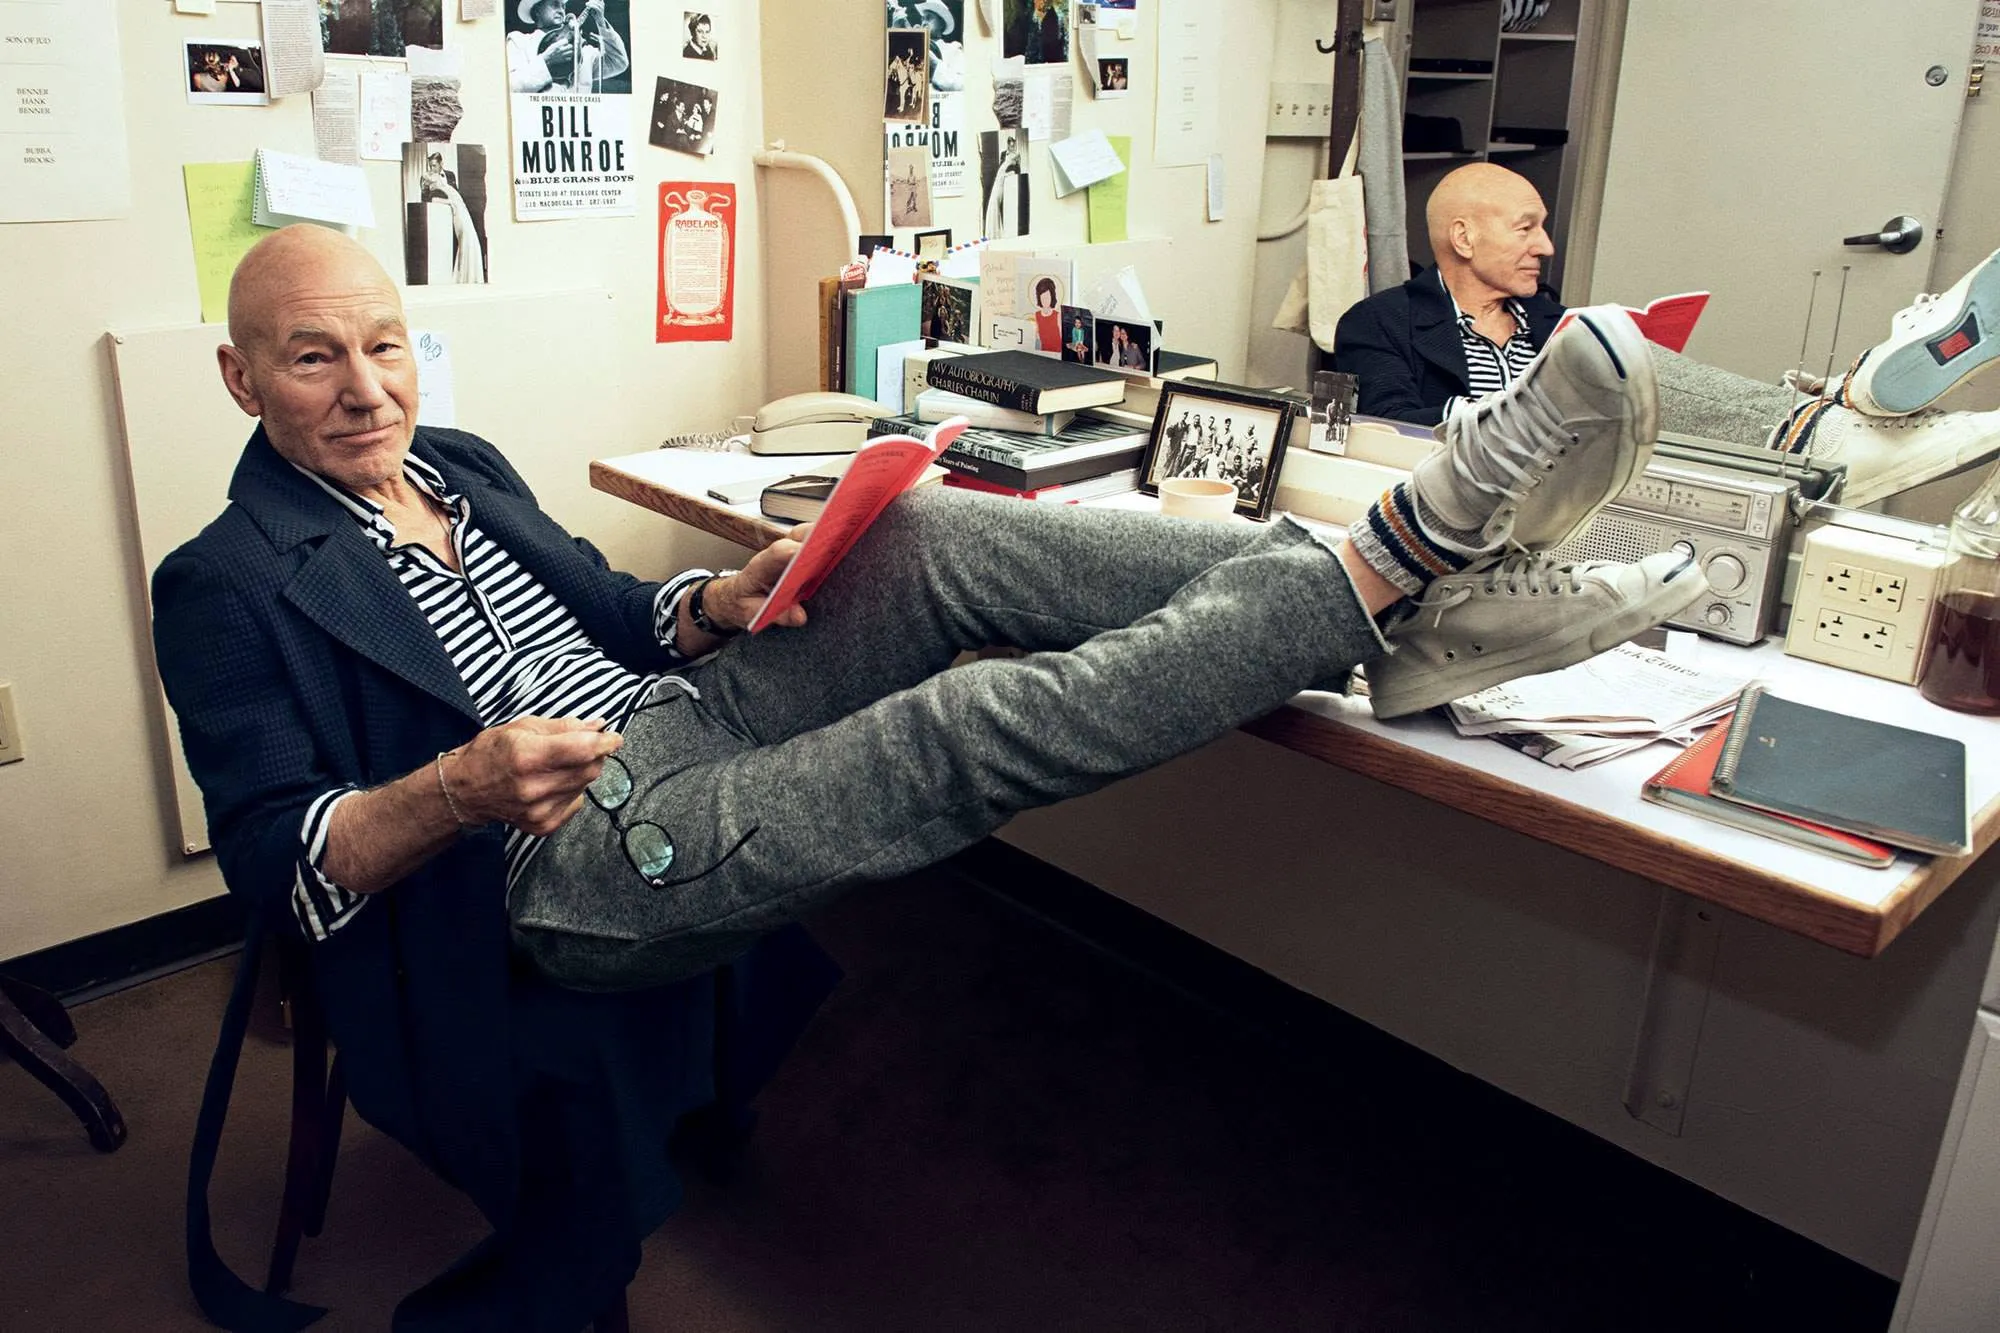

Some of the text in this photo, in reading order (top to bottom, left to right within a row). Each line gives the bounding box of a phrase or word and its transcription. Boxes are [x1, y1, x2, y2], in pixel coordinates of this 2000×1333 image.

[16, 87, 49, 95] BENNER
[541, 105, 592, 138] BILL
[522, 139, 625, 173] MONROE
[514, 177, 521, 185] &
[530, 176, 560, 185] BLUE
[562, 175, 601, 184] GRASS
[604, 174, 635, 183] BOYS
[675, 219, 719, 230] RABELAIS
[931, 360, 1020, 393] MY AUTOBIOGRAPHY
[930, 375, 965, 395] CHARLES
[965, 384, 1000, 404] CHAPLIN
[873, 419, 906, 434] PIERRE
[960, 461, 979, 473] Painting
[1613, 648, 1701, 677] ork Times
